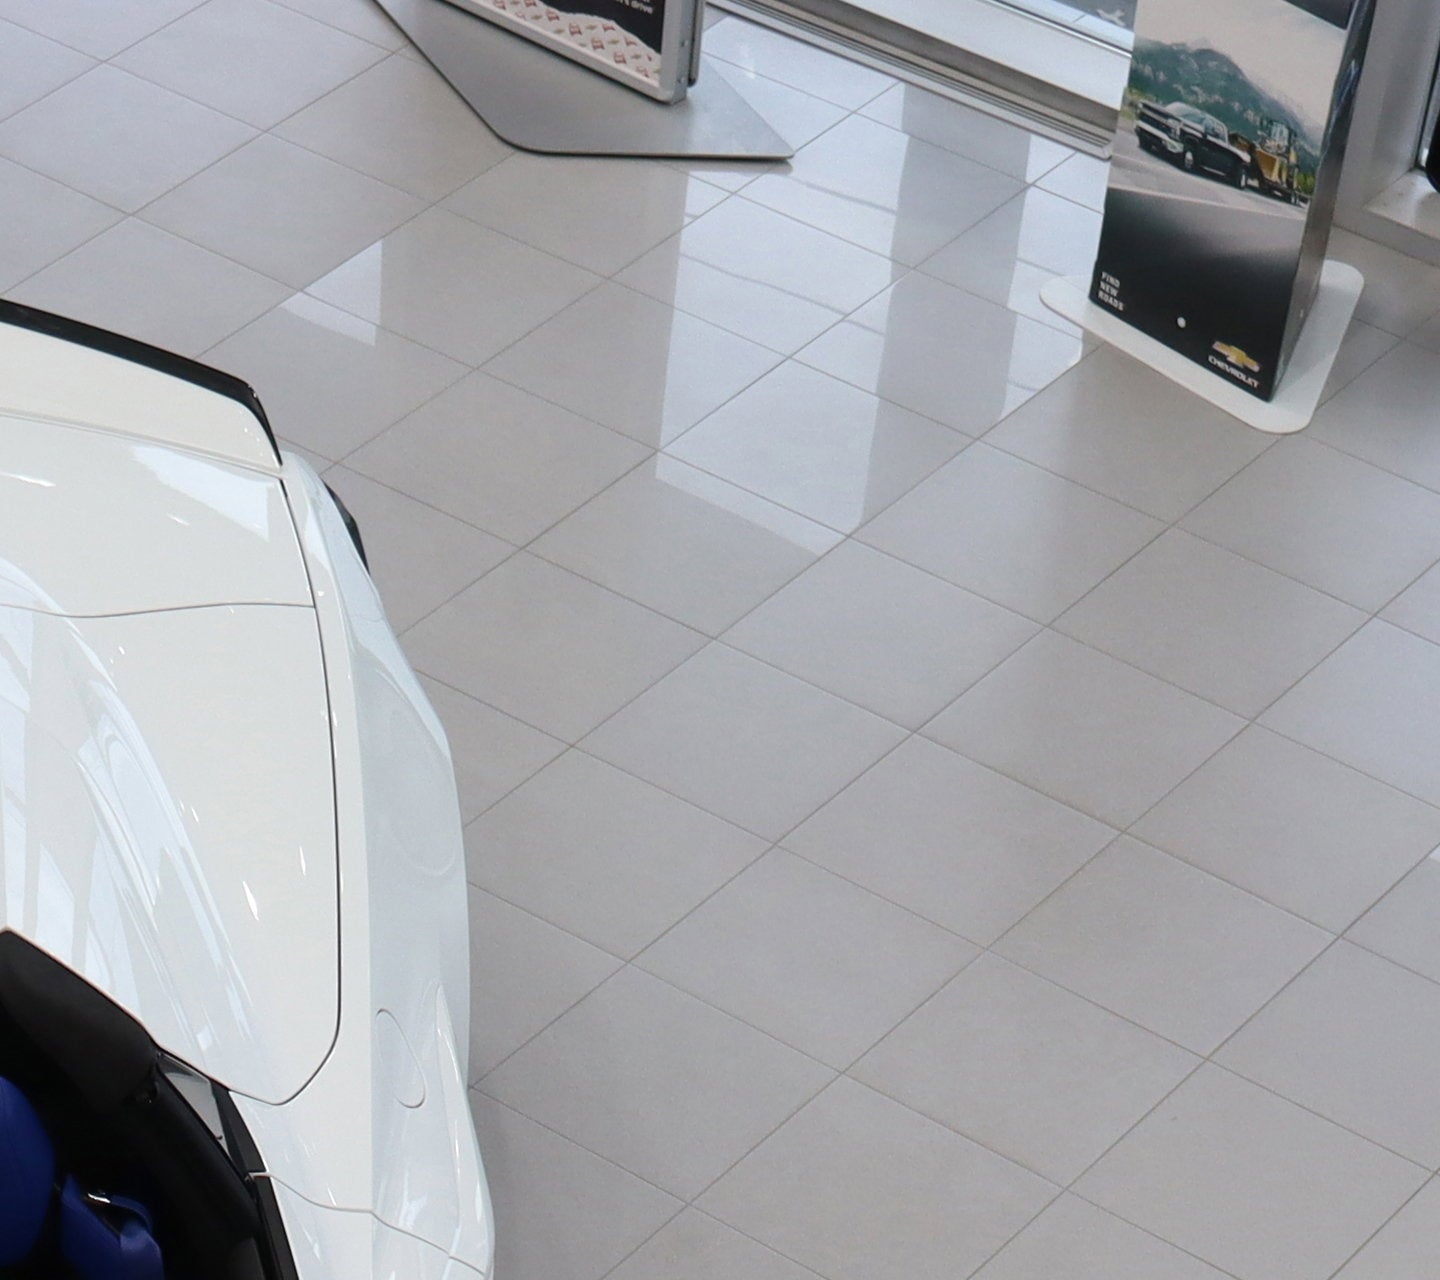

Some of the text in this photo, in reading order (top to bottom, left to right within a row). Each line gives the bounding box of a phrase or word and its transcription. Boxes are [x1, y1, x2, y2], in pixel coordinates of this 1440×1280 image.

[1102, 272, 1120, 287] FIND
[1100, 281, 1118, 297] NEW
[1098, 290, 1124, 311] ROADS
[1208, 355, 1259, 388] CHEVROLET
